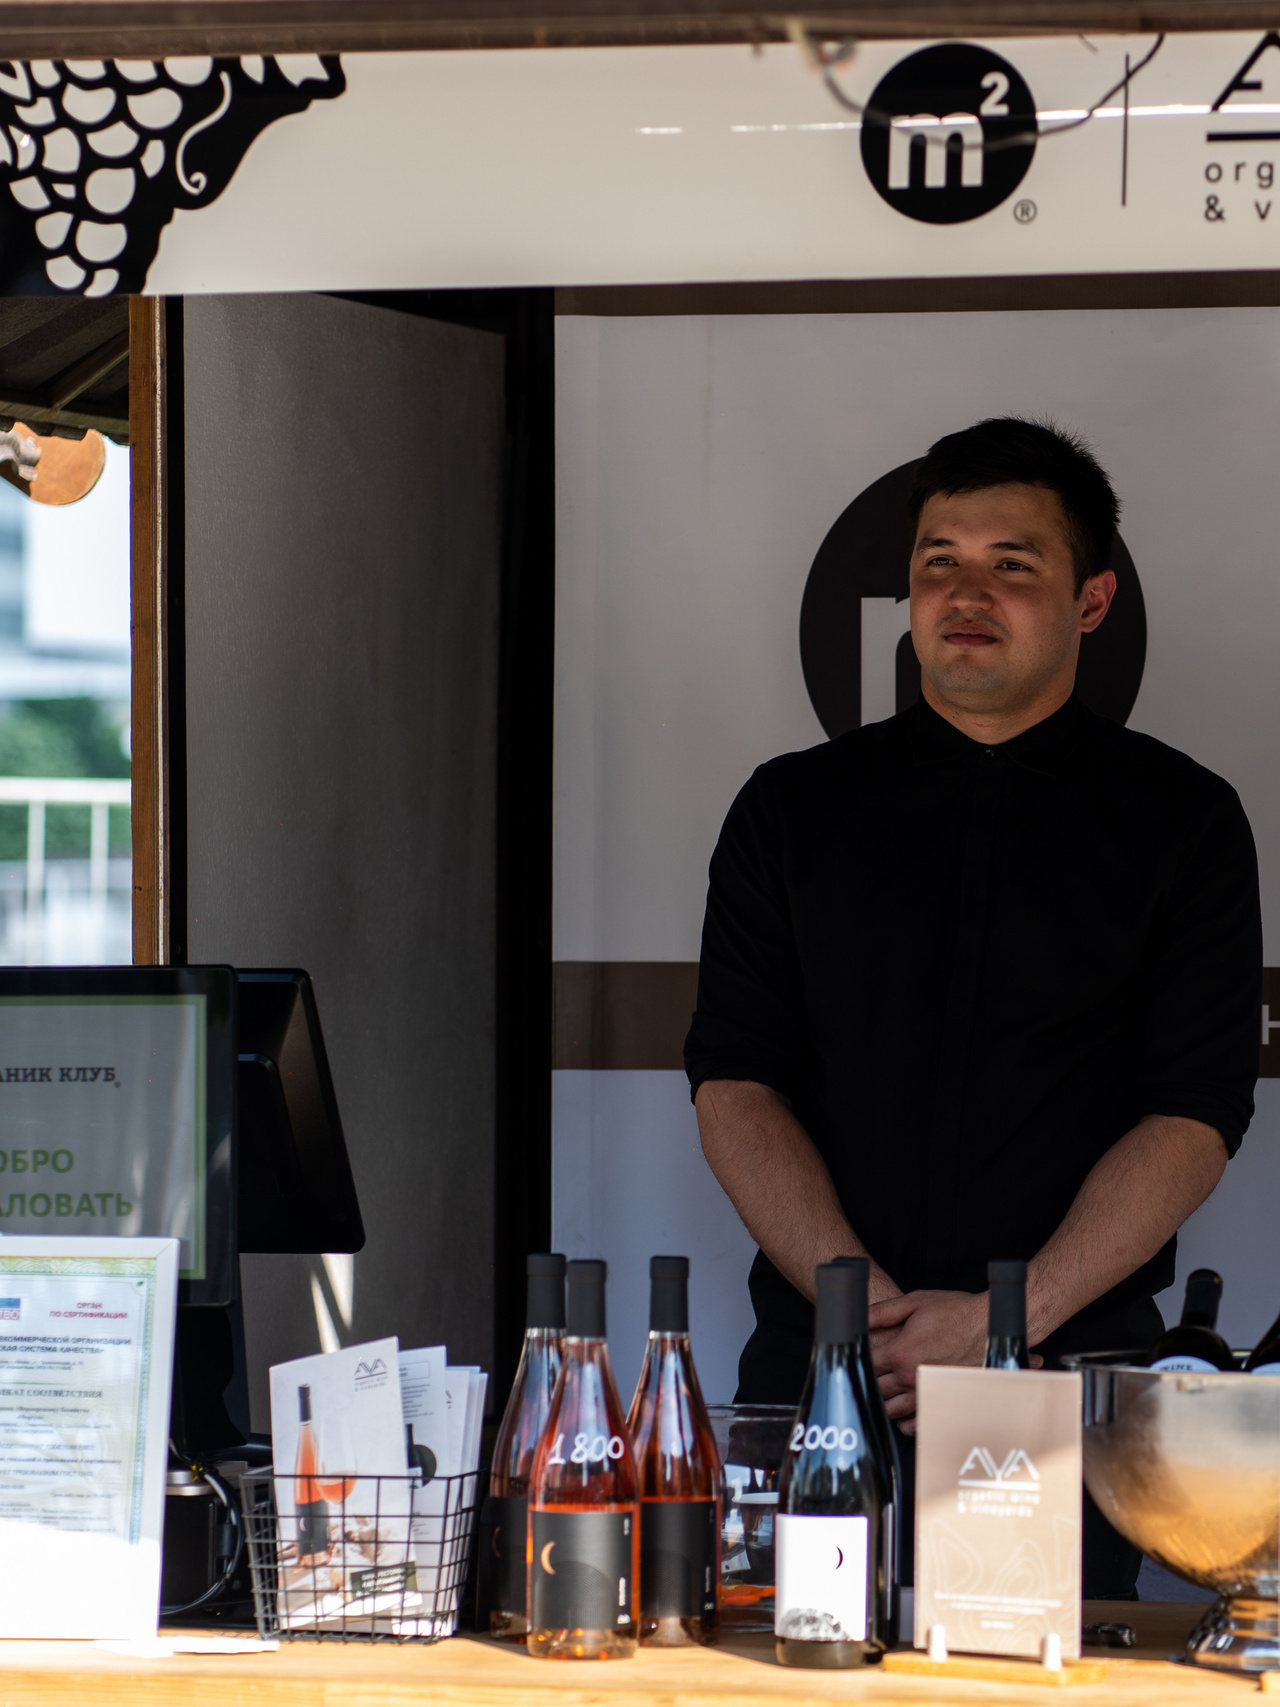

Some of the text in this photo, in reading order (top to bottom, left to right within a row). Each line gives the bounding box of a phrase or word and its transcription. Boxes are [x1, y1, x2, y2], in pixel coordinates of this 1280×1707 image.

[1203, 195, 1226, 223] &
[58, 1067, 116, 1083] КЛУБ
[0, 1193, 134, 1218] ЛОВАТЬ
[547, 1432, 626, 1464] 1800
[789, 1423, 859, 1453] 2000
